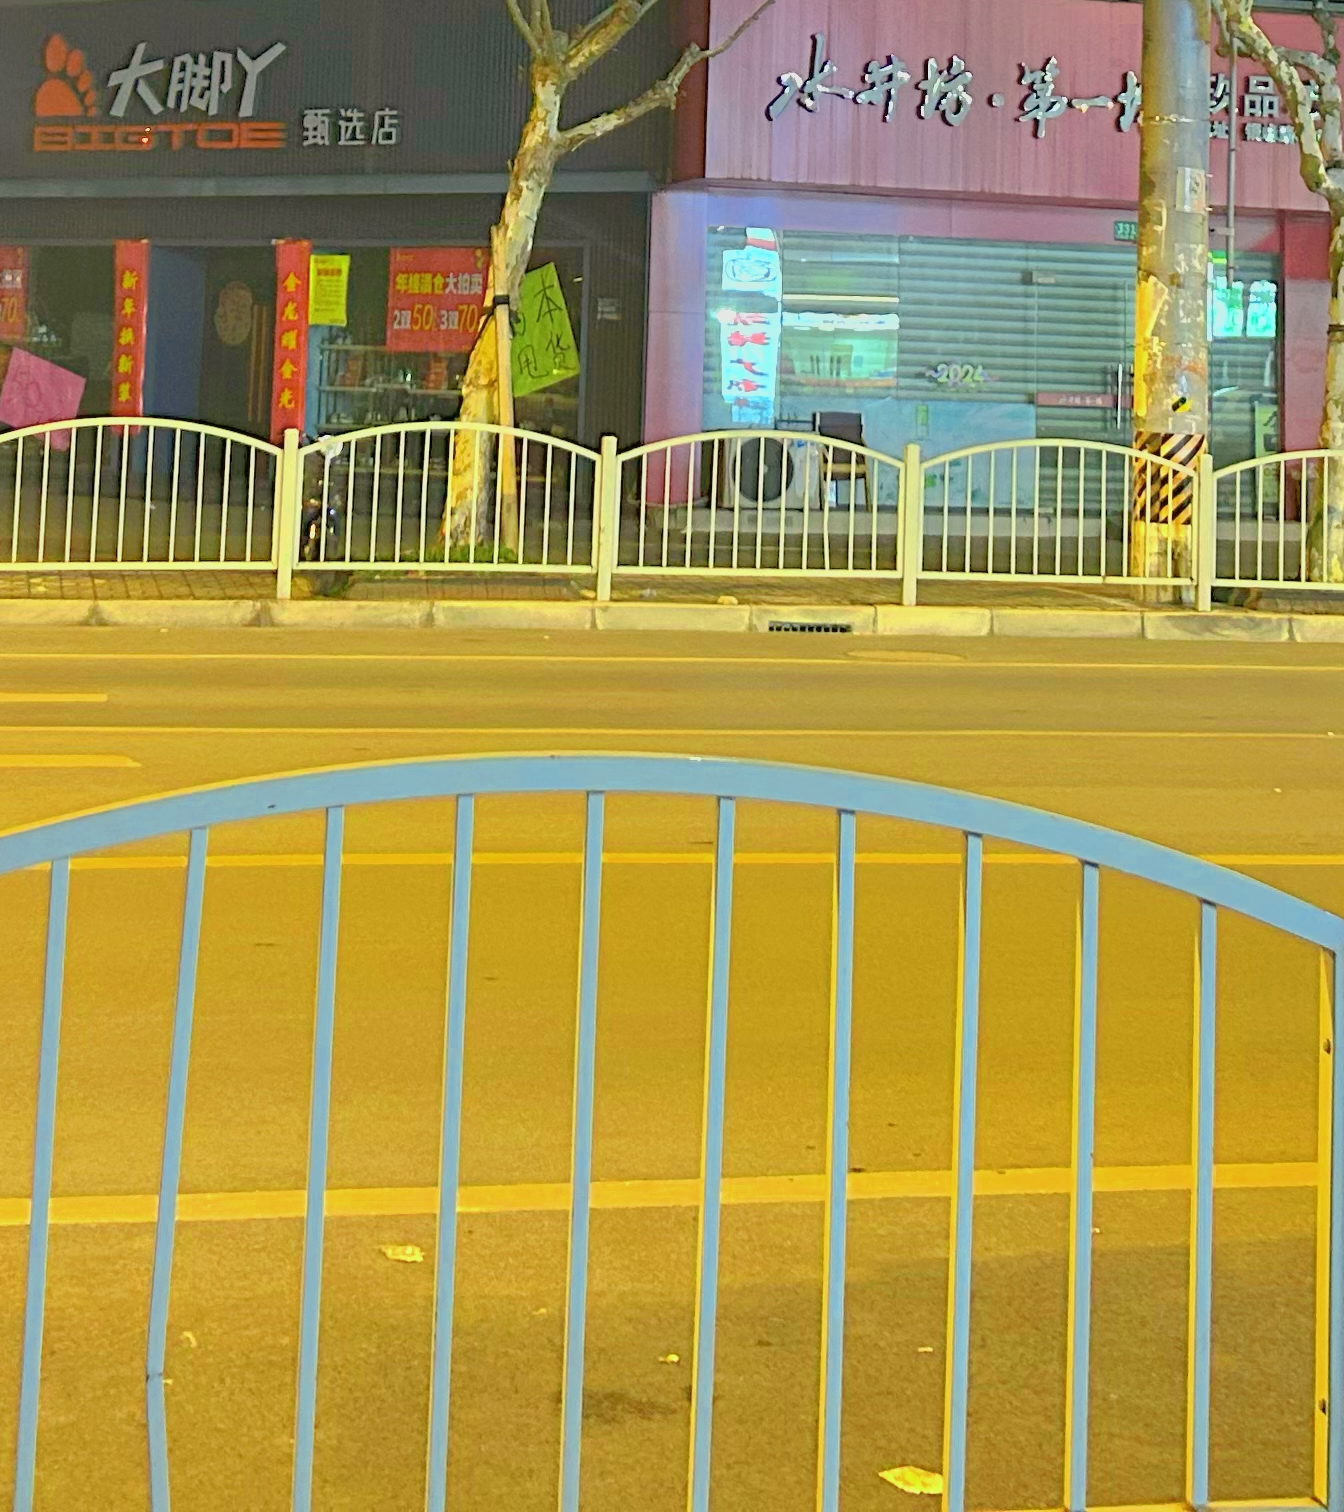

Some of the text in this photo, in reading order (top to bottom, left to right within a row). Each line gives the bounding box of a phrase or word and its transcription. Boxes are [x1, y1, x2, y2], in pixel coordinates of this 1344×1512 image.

[33, 122, 287, 152] BIGTOE
[302, 108, 400, 147] 甄选店
[936, 362, 985, 385] 2024
